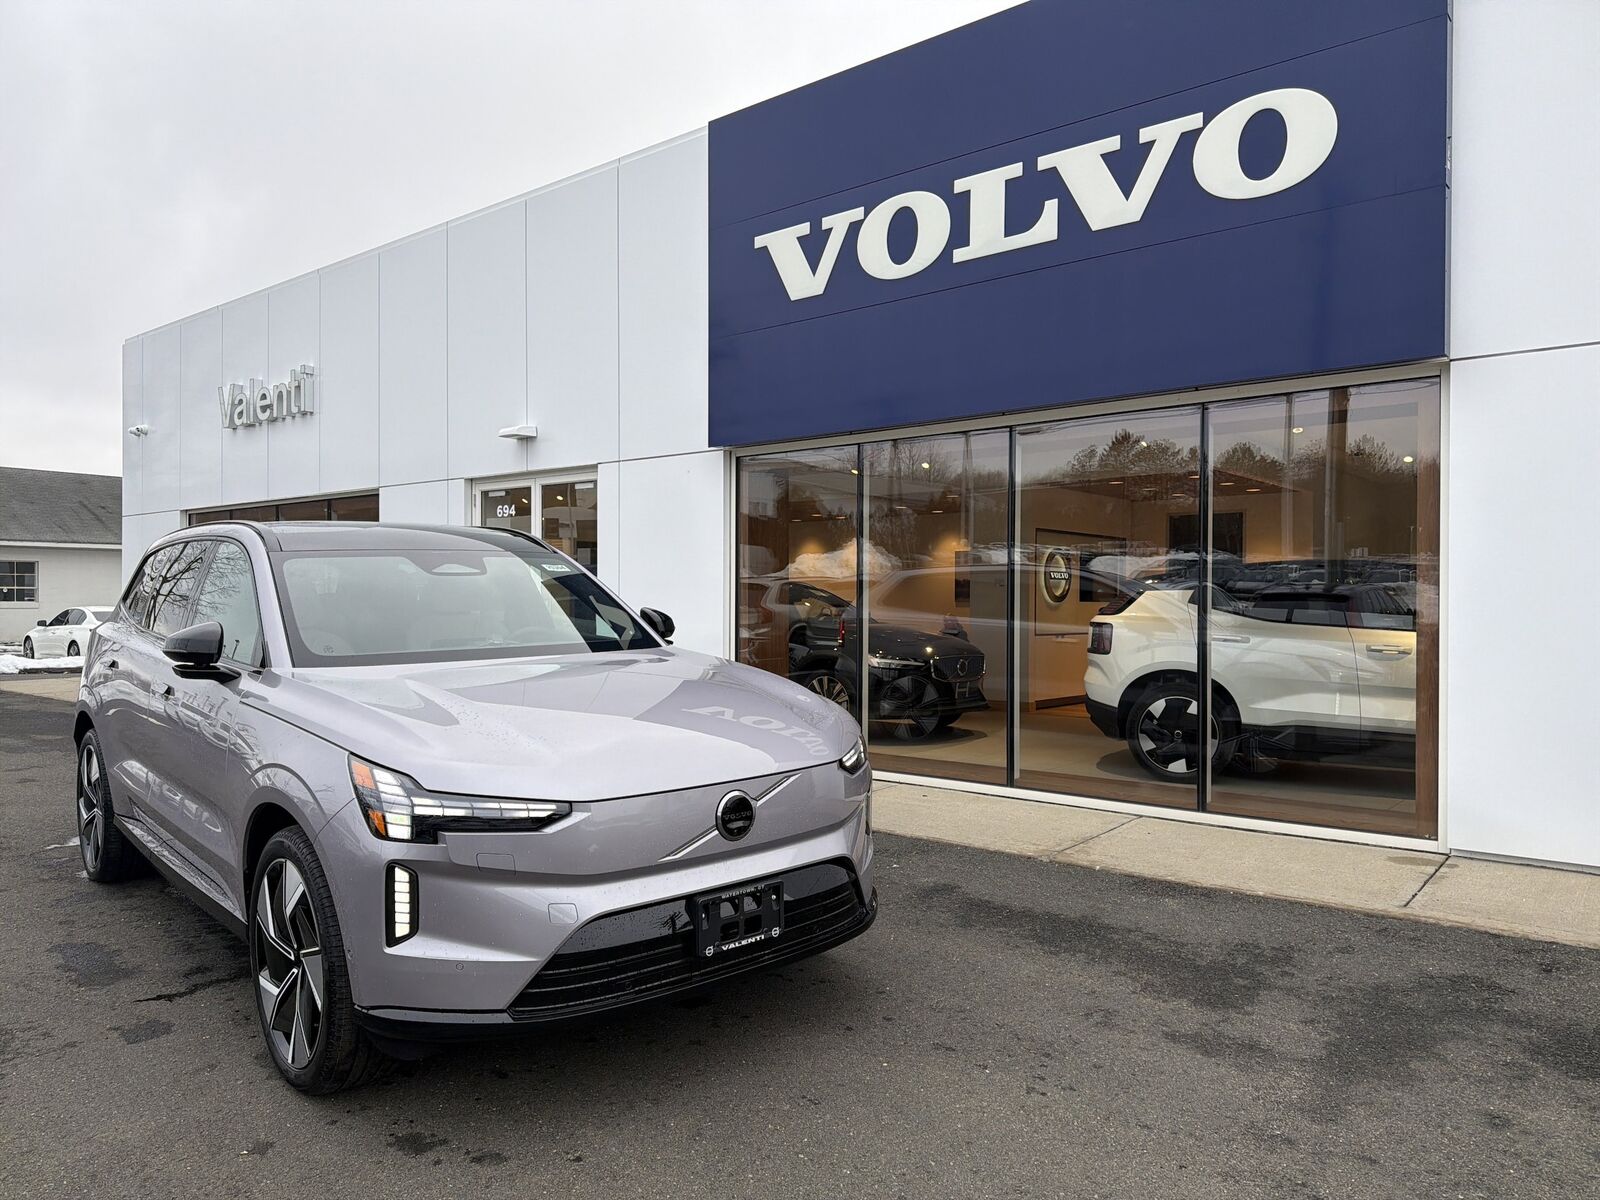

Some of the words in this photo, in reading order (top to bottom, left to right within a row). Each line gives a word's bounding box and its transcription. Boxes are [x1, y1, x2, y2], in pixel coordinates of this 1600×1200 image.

[754, 87, 1338, 301] VOLVO
[218, 364, 314, 430] Valenti
[496, 504, 516, 518] 694
[721, 934, 765, 951] VALENTI
